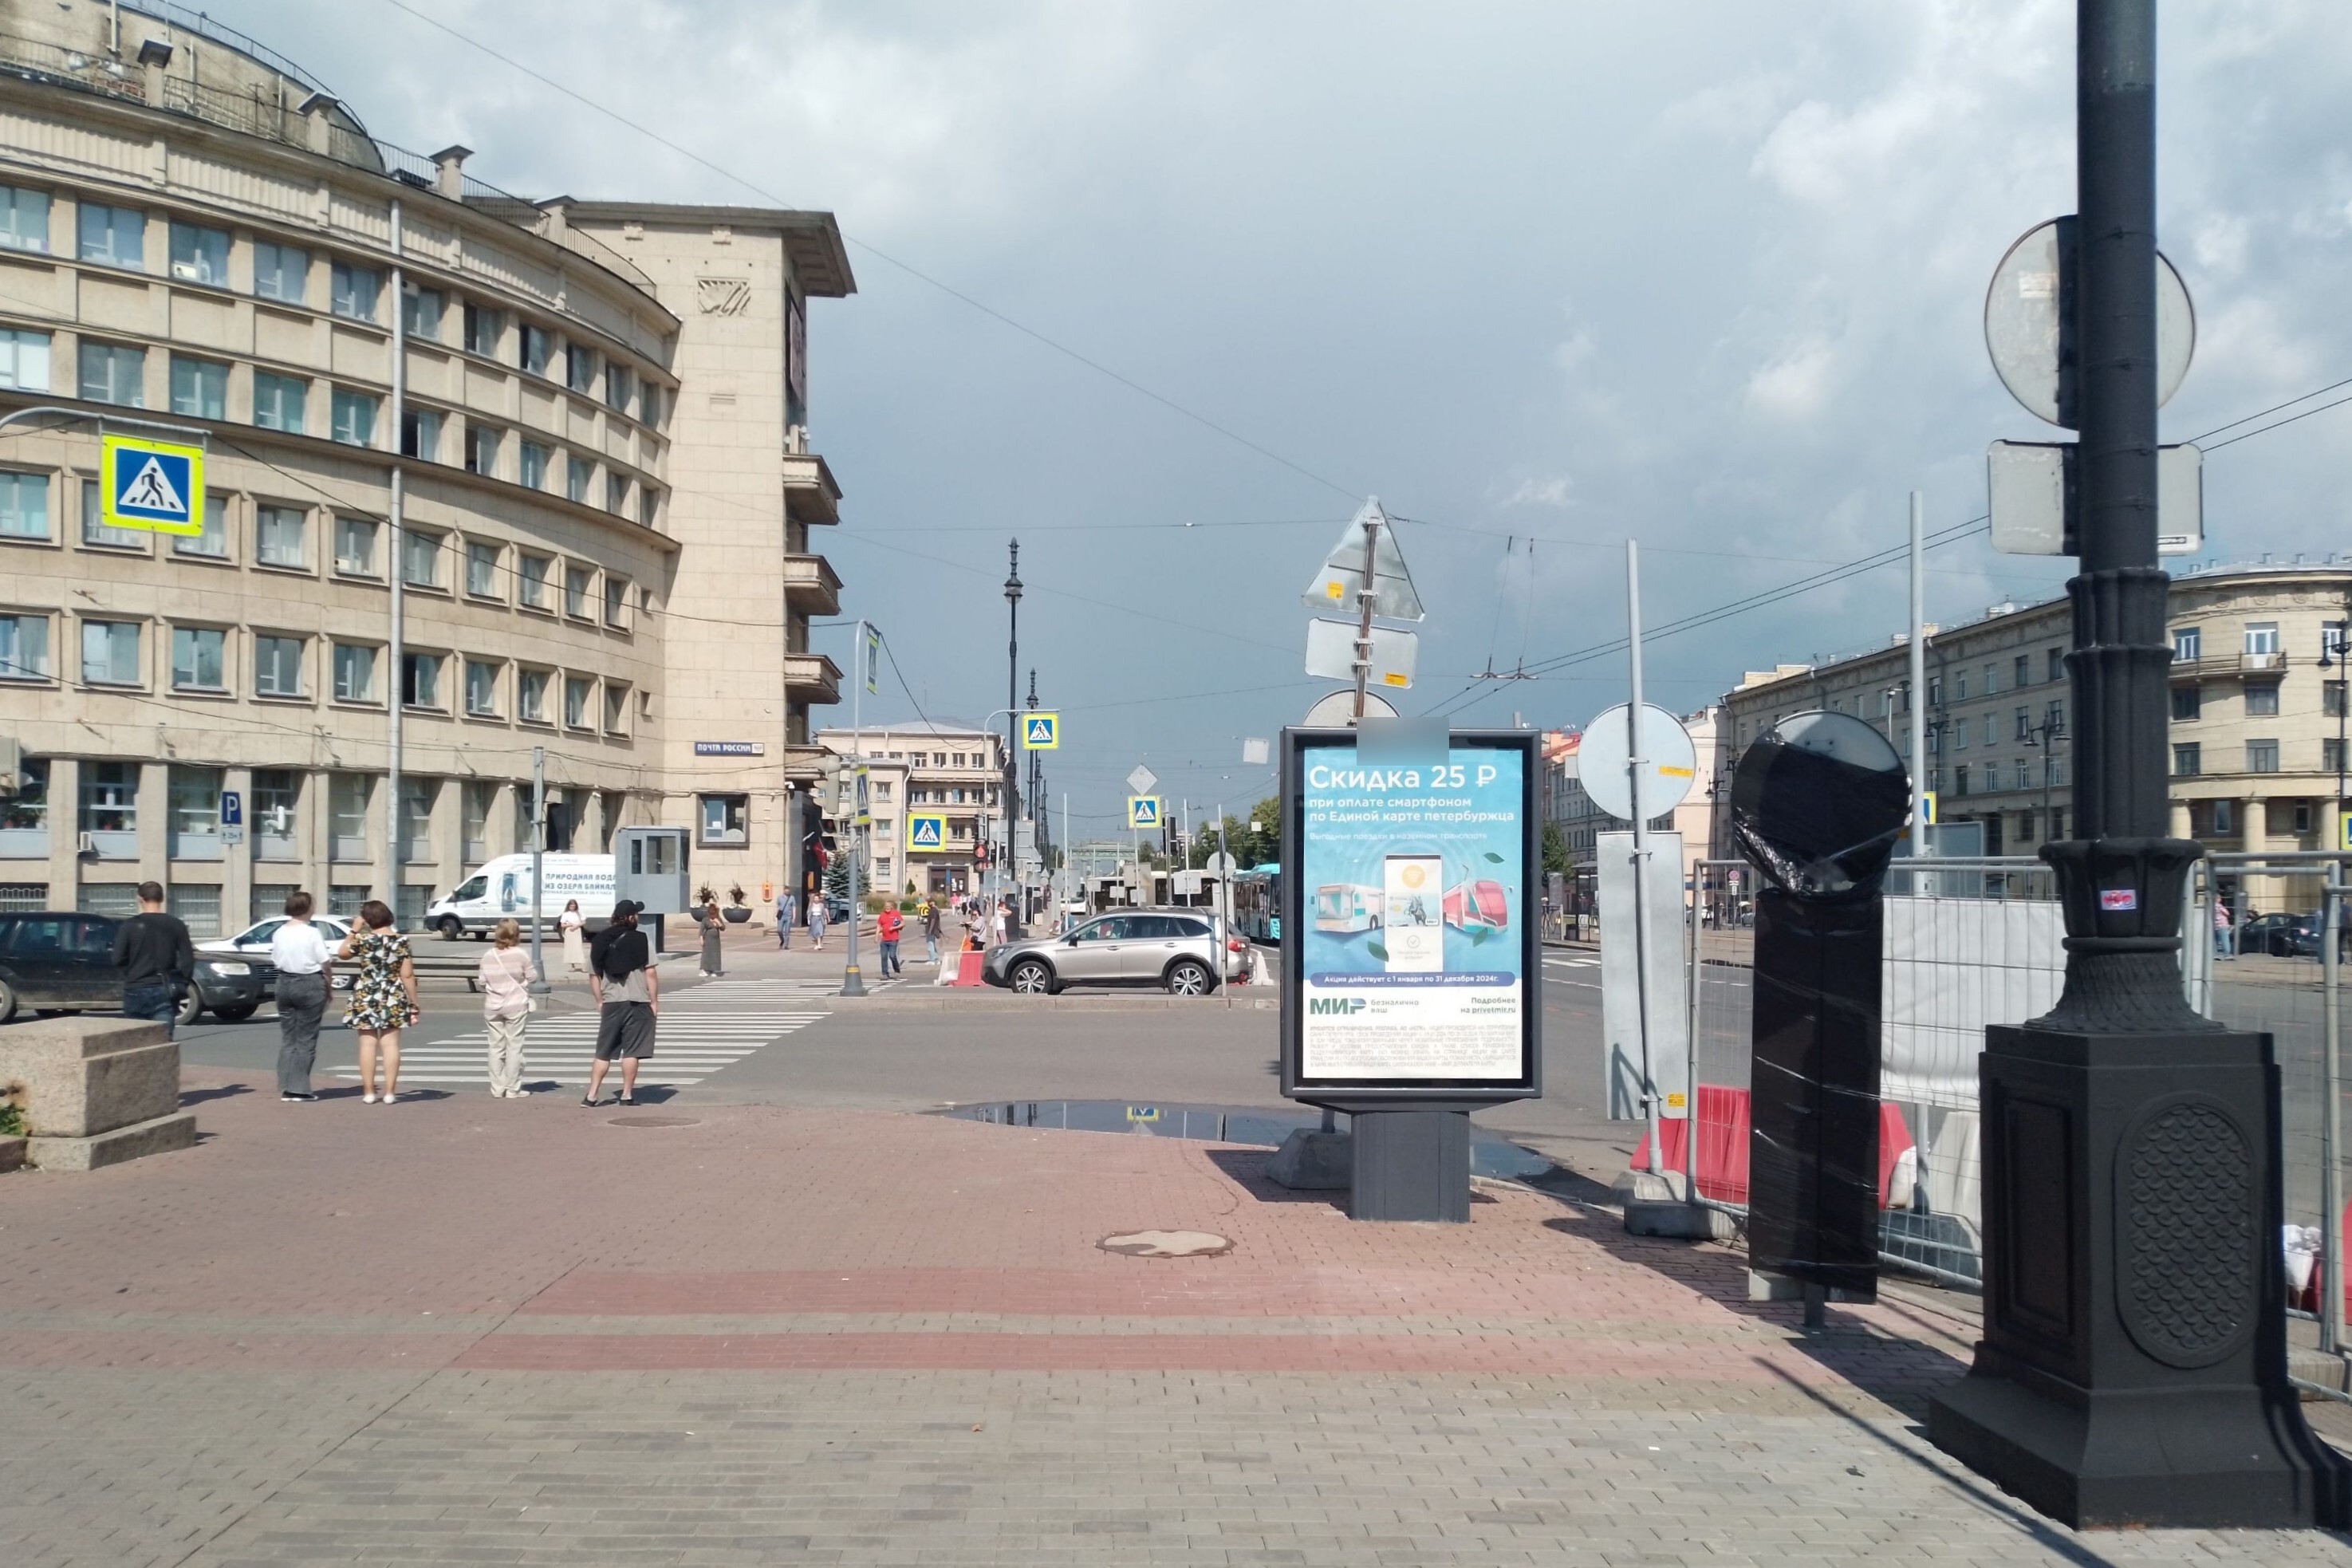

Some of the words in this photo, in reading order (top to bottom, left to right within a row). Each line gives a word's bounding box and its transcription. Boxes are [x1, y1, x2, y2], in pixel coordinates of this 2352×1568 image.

[1309, 766, 1420, 791] Скидка
[1430, 766, 1466, 788] 25
[227, 795, 238, 821] P
[1310, 798, 1334, 809] при
[1338, 798, 1384, 807] оплате
[1388, 796, 1471, 809] смартфоном
[1310, 813, 1326, 821] по
[1330, 810, 1378, 823] Единой
[1383, 813, 1420, 823] карте
[1424, 810, 1515, 823] петербуржца
[1310, 998, 1366, 1014] МИР
